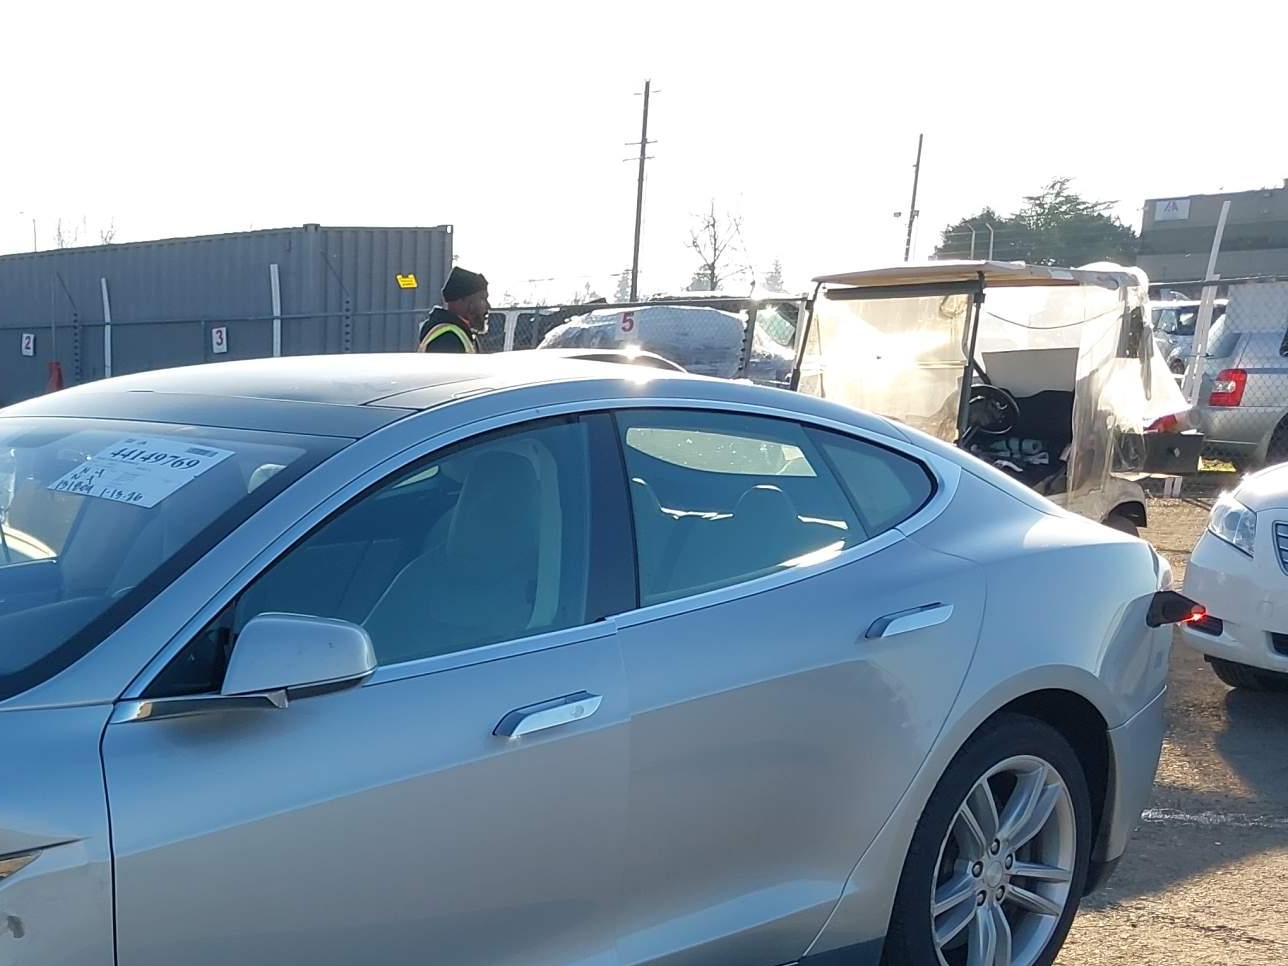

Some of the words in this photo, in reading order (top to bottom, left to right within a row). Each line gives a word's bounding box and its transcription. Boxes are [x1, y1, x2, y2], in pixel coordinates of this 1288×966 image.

[621, 311, 634, 332] 5
[24, 335, 31, 350] 2
[215, 329, 223, 346] 3
[109, 447, 201, 470] 44149769
